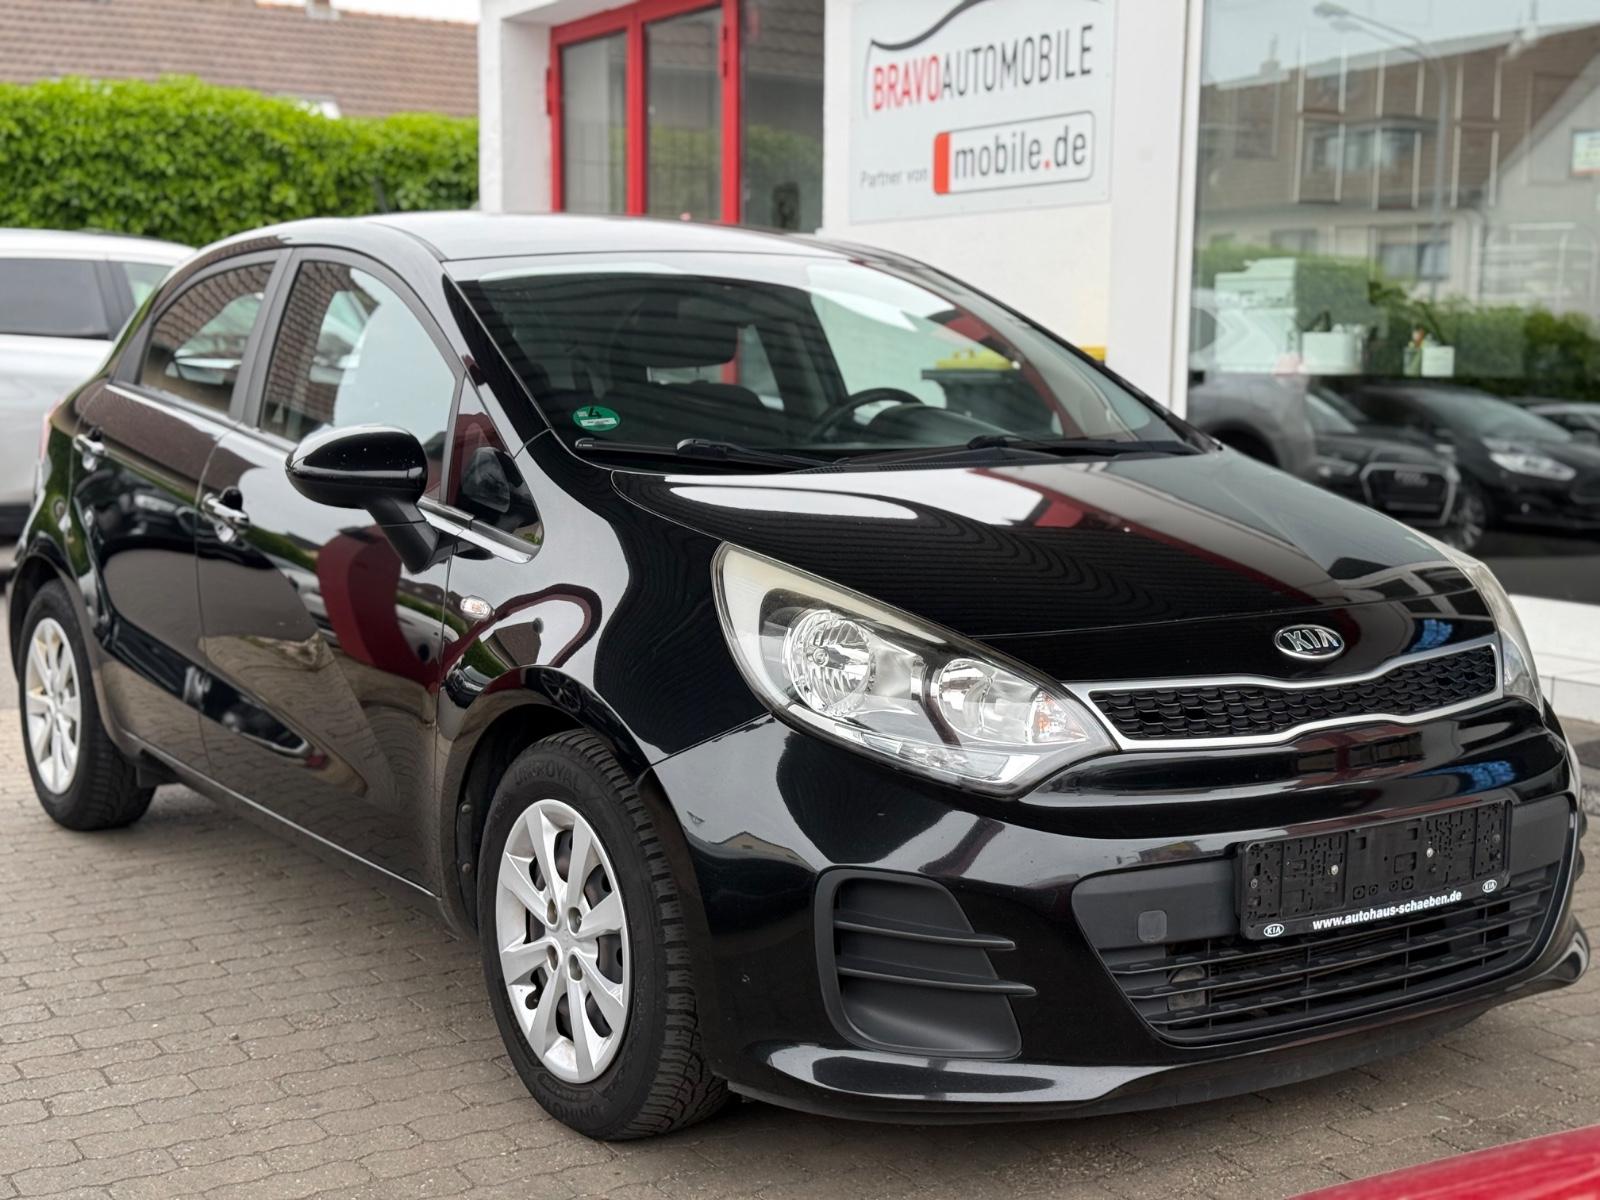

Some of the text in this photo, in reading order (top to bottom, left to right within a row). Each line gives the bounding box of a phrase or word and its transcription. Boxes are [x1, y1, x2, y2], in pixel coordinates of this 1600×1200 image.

[872, 24, 1094, 111] BRAVOAUTOMOBILE
[953, 124, 1087, 180] mobile.de
[1282, 628, 1340, 653] KIA
[1312, 889, 1463, 930] www.autohaus-schaeben.de
